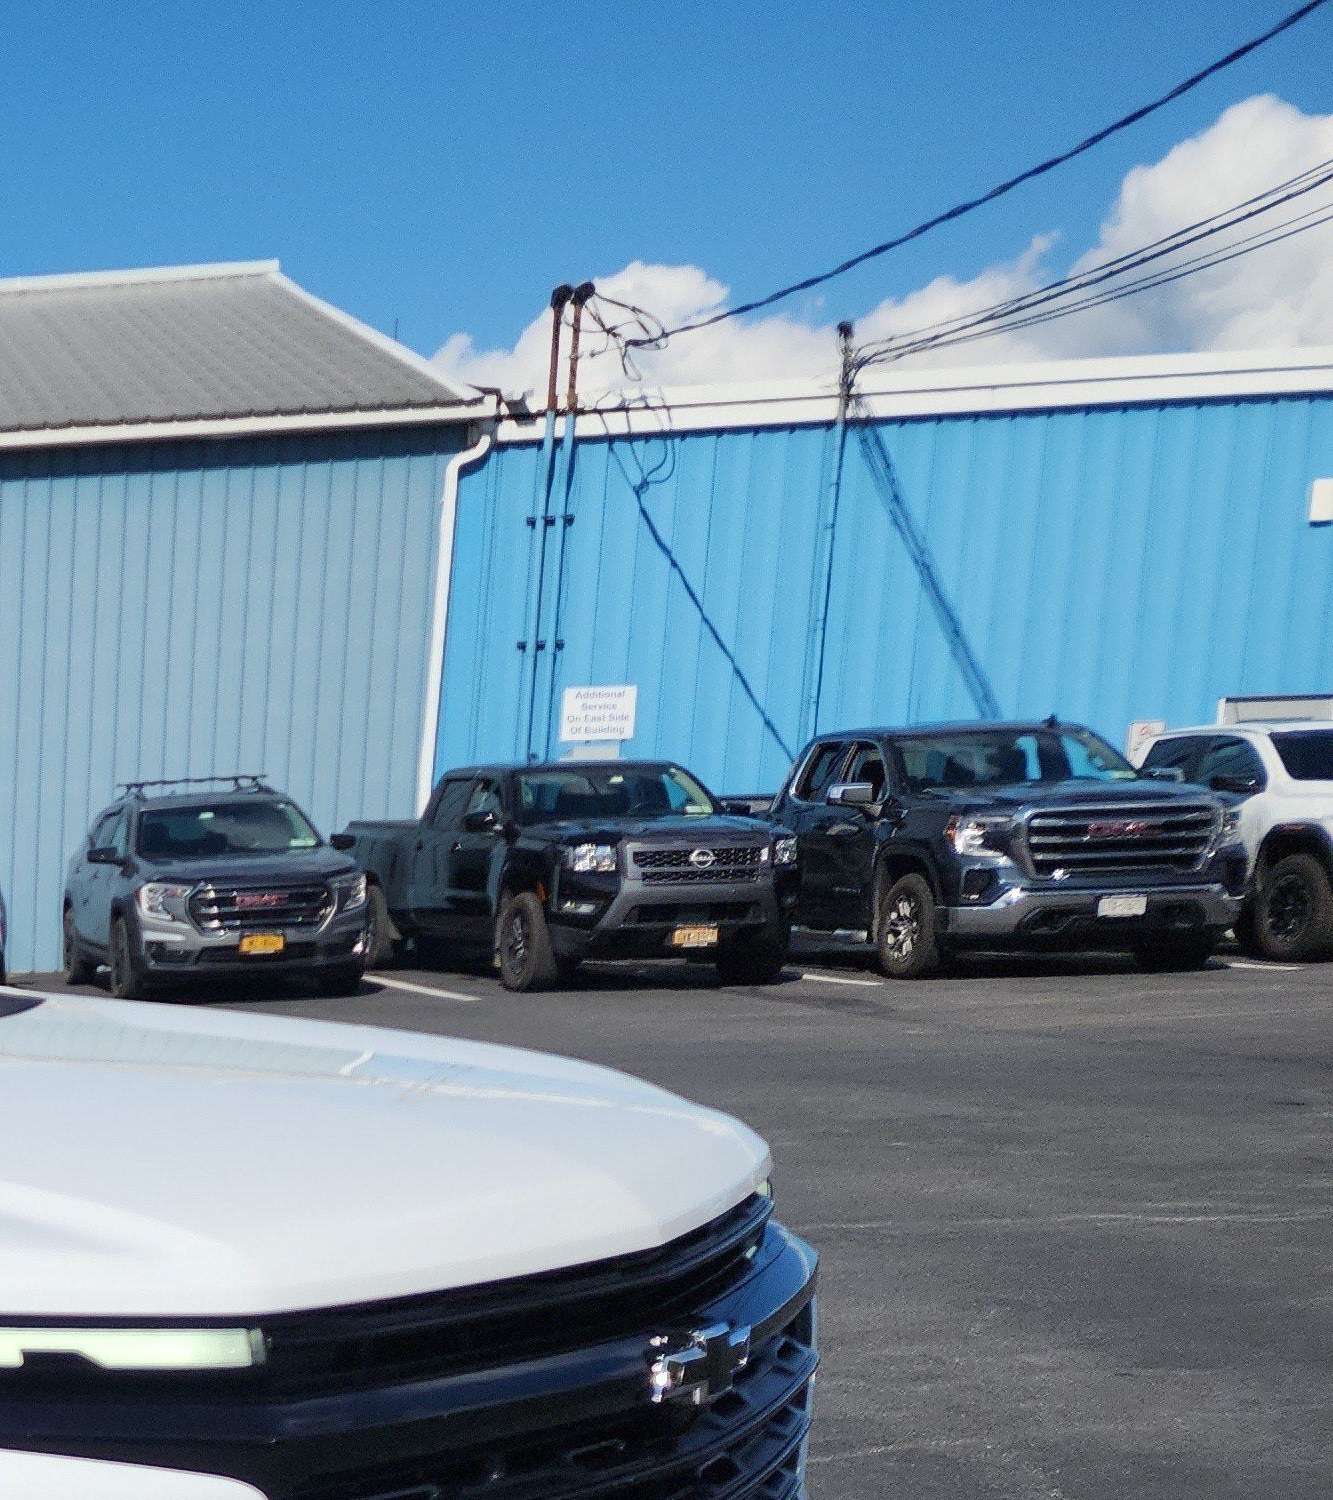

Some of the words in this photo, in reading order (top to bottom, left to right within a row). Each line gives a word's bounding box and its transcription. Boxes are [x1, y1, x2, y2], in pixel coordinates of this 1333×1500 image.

[576, 690, 625, 700] Additional
[581, 703, 618, 711] Service
[567, 714, 581, 723] On
[584, 713, 606, 723] East
[608, 712, 630, 721] Side
[570, 726, 582, 735] Of
[584, 725, 626, 735] Building
